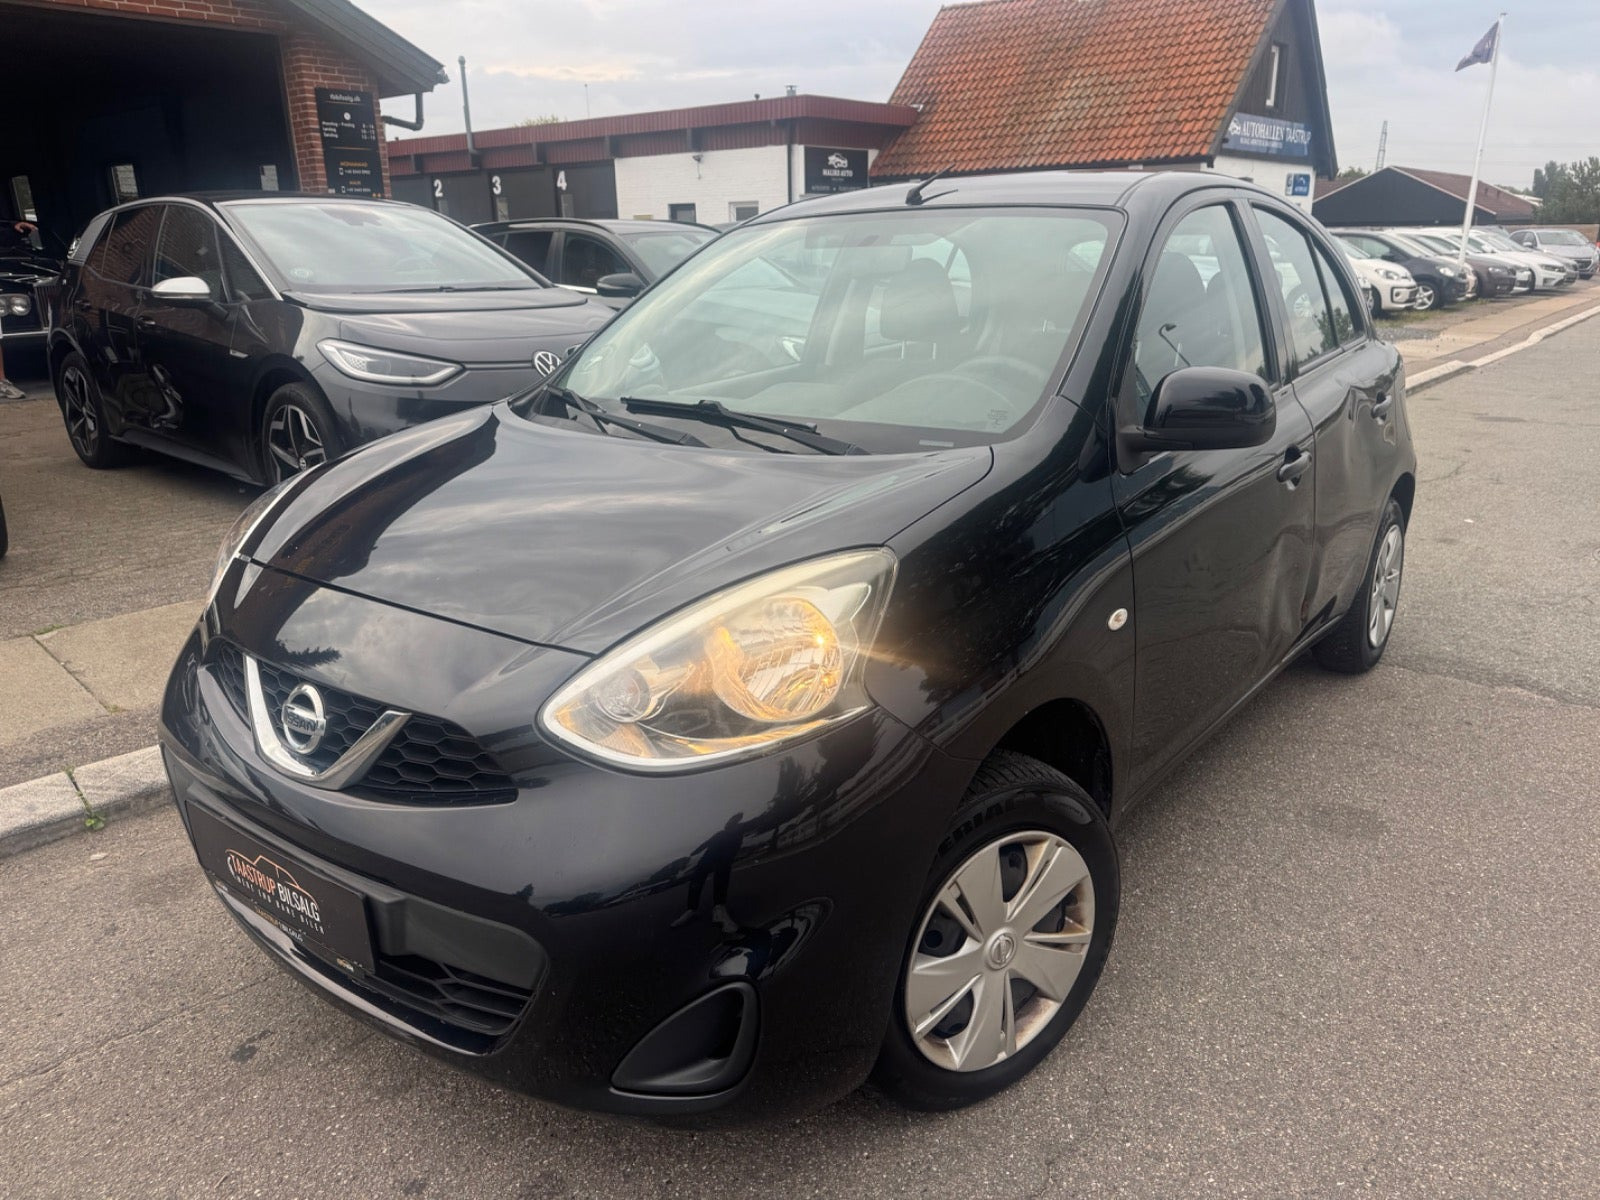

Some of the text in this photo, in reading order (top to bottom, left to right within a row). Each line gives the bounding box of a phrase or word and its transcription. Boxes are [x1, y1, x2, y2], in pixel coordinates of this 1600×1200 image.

[1242, 121, 1284, 141] AUTOHALLEN
[434, 179, 443, 197] 2
[492, 175, 501, 194] 3
[556, 170, 567, 191] 4
[230, 854, 320, 922] TAASTRUP BILSALG
